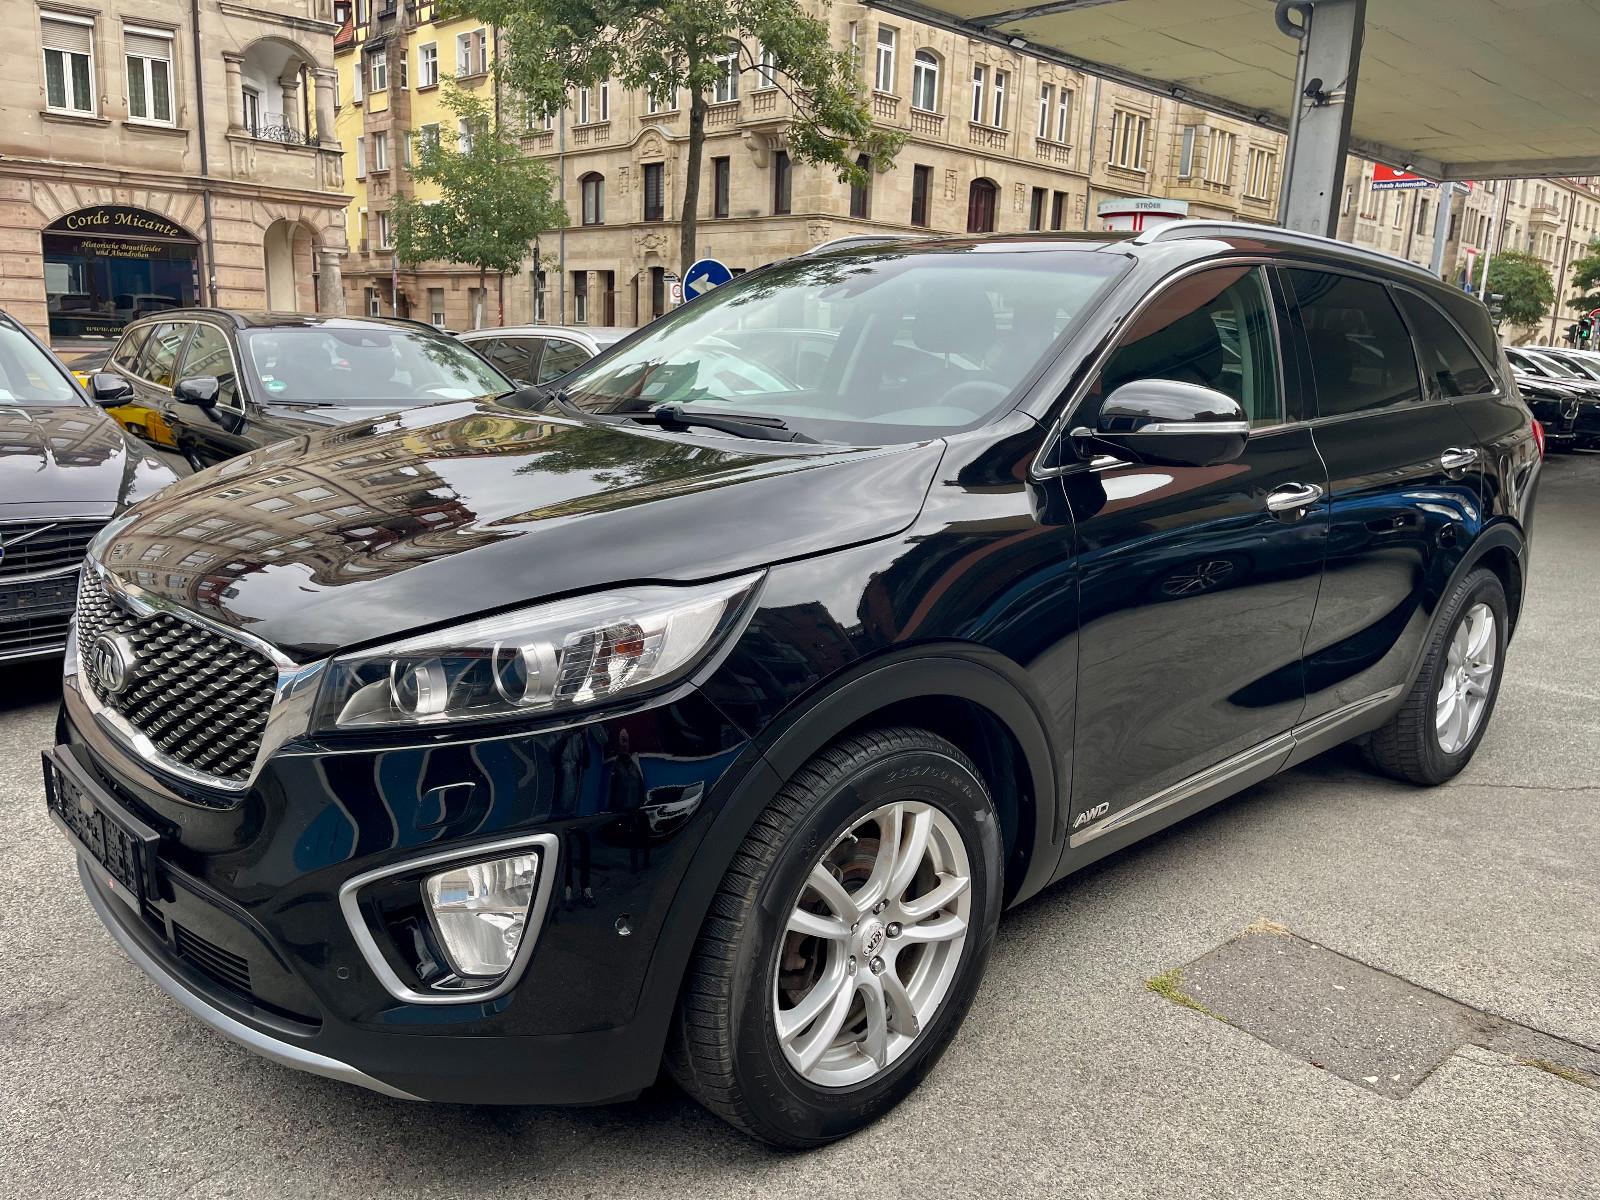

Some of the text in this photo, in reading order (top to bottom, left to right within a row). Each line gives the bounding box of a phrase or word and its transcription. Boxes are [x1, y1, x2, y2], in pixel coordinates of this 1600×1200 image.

[1395, 180, 1428, 189] Automobile
[66, 210, 179, 237] Corde Micante
[81, 240, 162, 253] Historische Brautkleider
[1072, 801, 1110, 829] AWD
